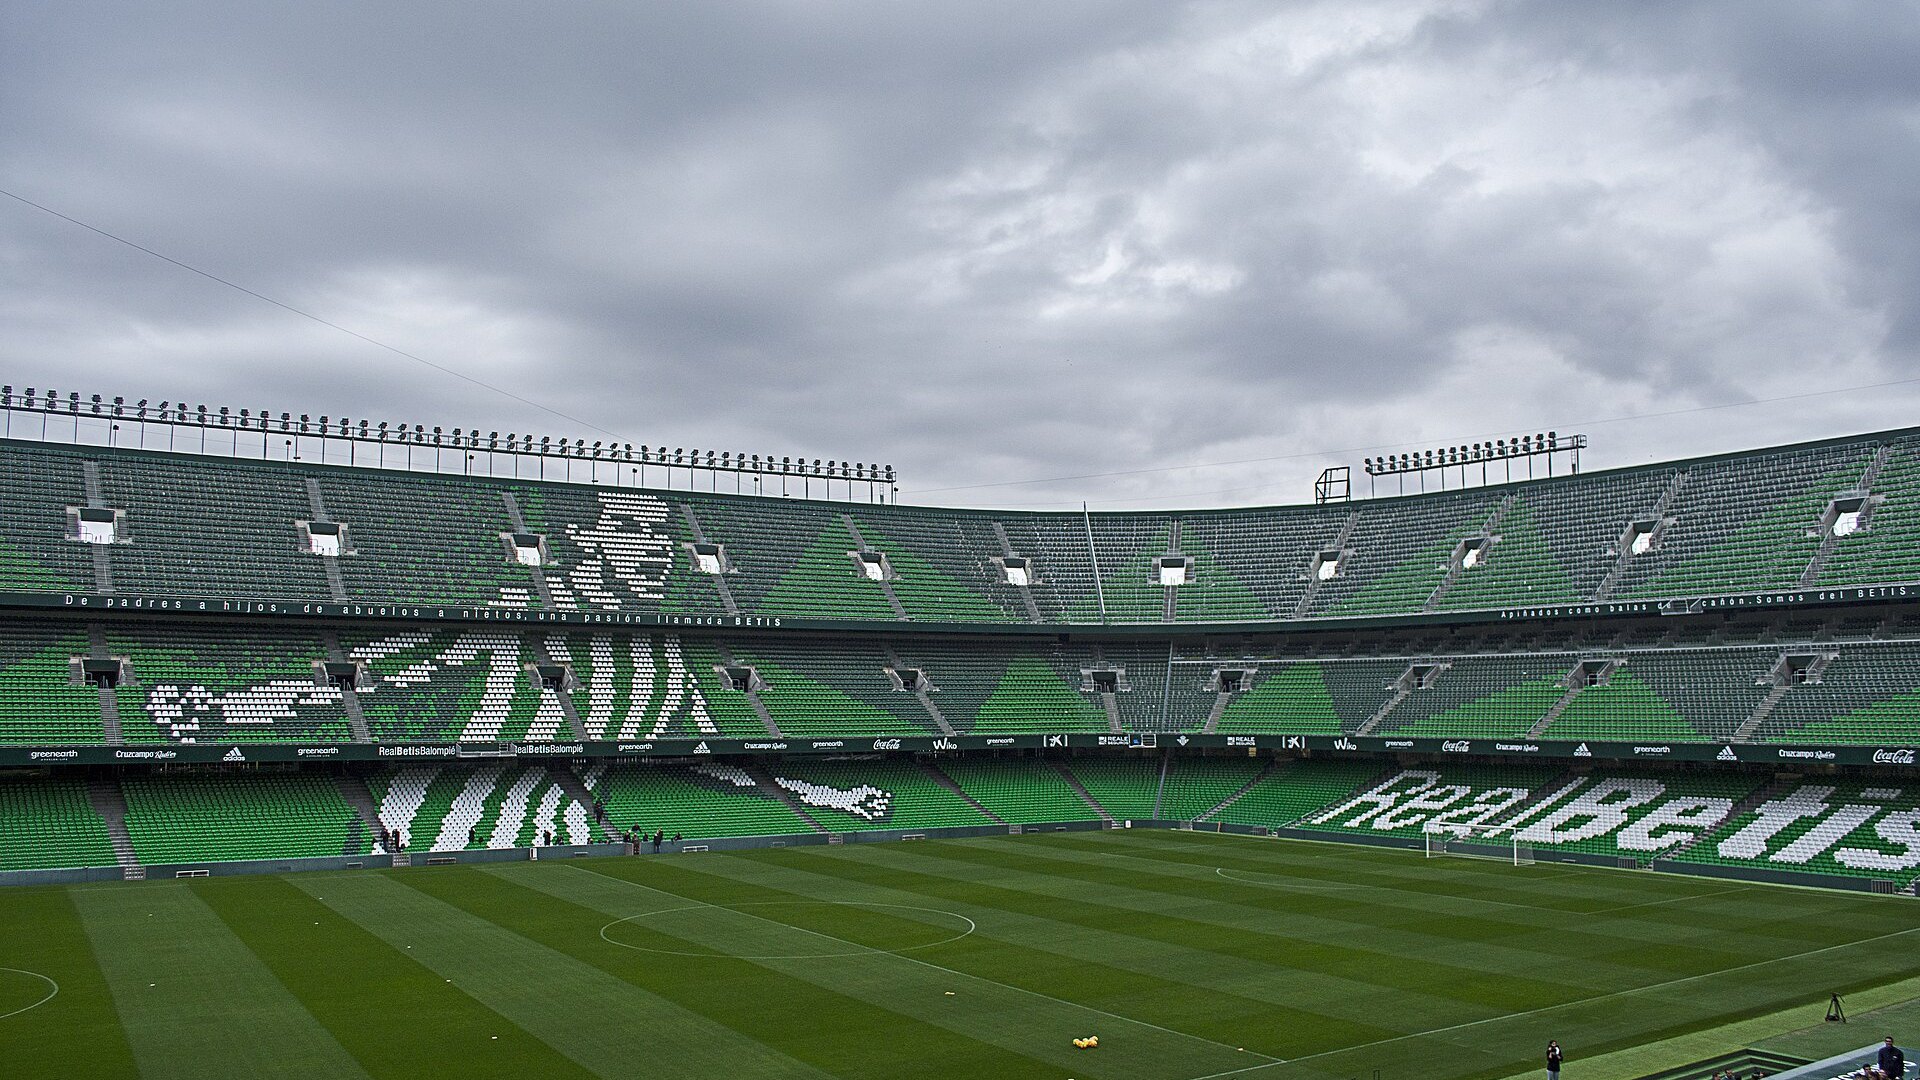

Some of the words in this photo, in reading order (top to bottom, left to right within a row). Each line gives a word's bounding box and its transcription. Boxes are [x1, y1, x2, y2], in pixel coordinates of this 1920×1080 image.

[1567, 605, 1599, 614] como
[1818, 590, 1843, 600] del
[66, 594, 89, 605] De
[107, 596, 183, 608] padres
[199, 599, 207, 609] a
[222, 600, 287, 613] hijos,
[304, 602, 324, 613] de
[341, 604, 420, 616] abuelos
[438, 607, 444, 617] a
[462, 608, 529, 620] nietos,
[539, 611, 568, 620] una
[583, 612, 640, 623] pasión
[656, 614, 724, 625] llamada
[735, 616, 781, 626] BETIS
[618, 743, 652, 751] greenearth
[813, 741, 843, 749] greenearth
[31, 750, 78, 760] greenearth
[116, 750, 154, 758] Cruzcampo
[298, 747, 338, 756] greenearth
[1779, 749, 1814, 758] Cruzcampo
